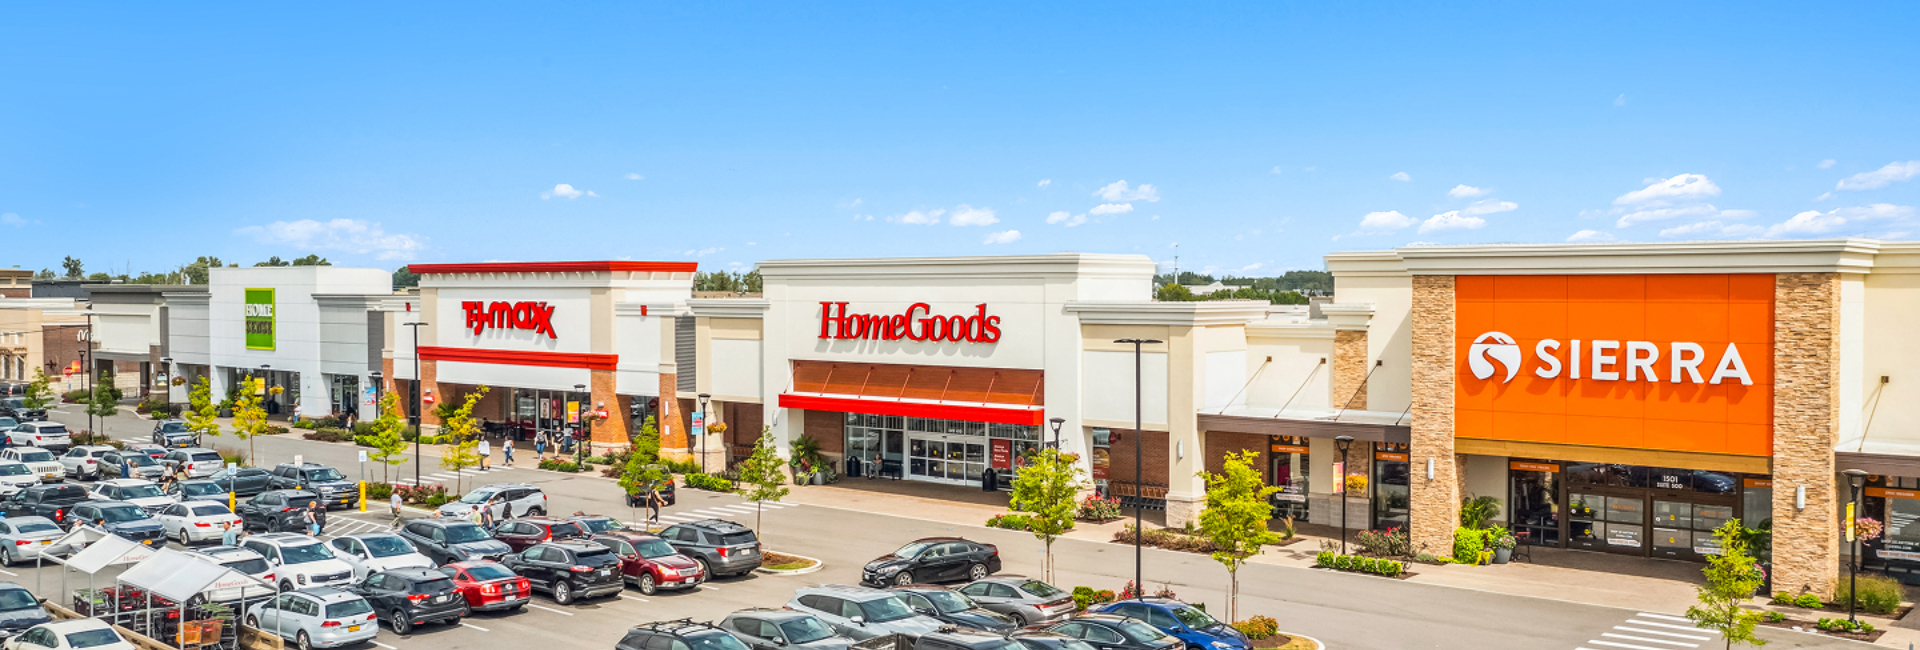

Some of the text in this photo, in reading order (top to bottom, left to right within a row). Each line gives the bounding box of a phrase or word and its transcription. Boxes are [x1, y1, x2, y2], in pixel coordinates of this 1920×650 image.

[818, 302, 1001, 343] HomeGoods
[1535, 339, 1753, 386] SIERRA
[1663, 475, 1678, 483] 1501
